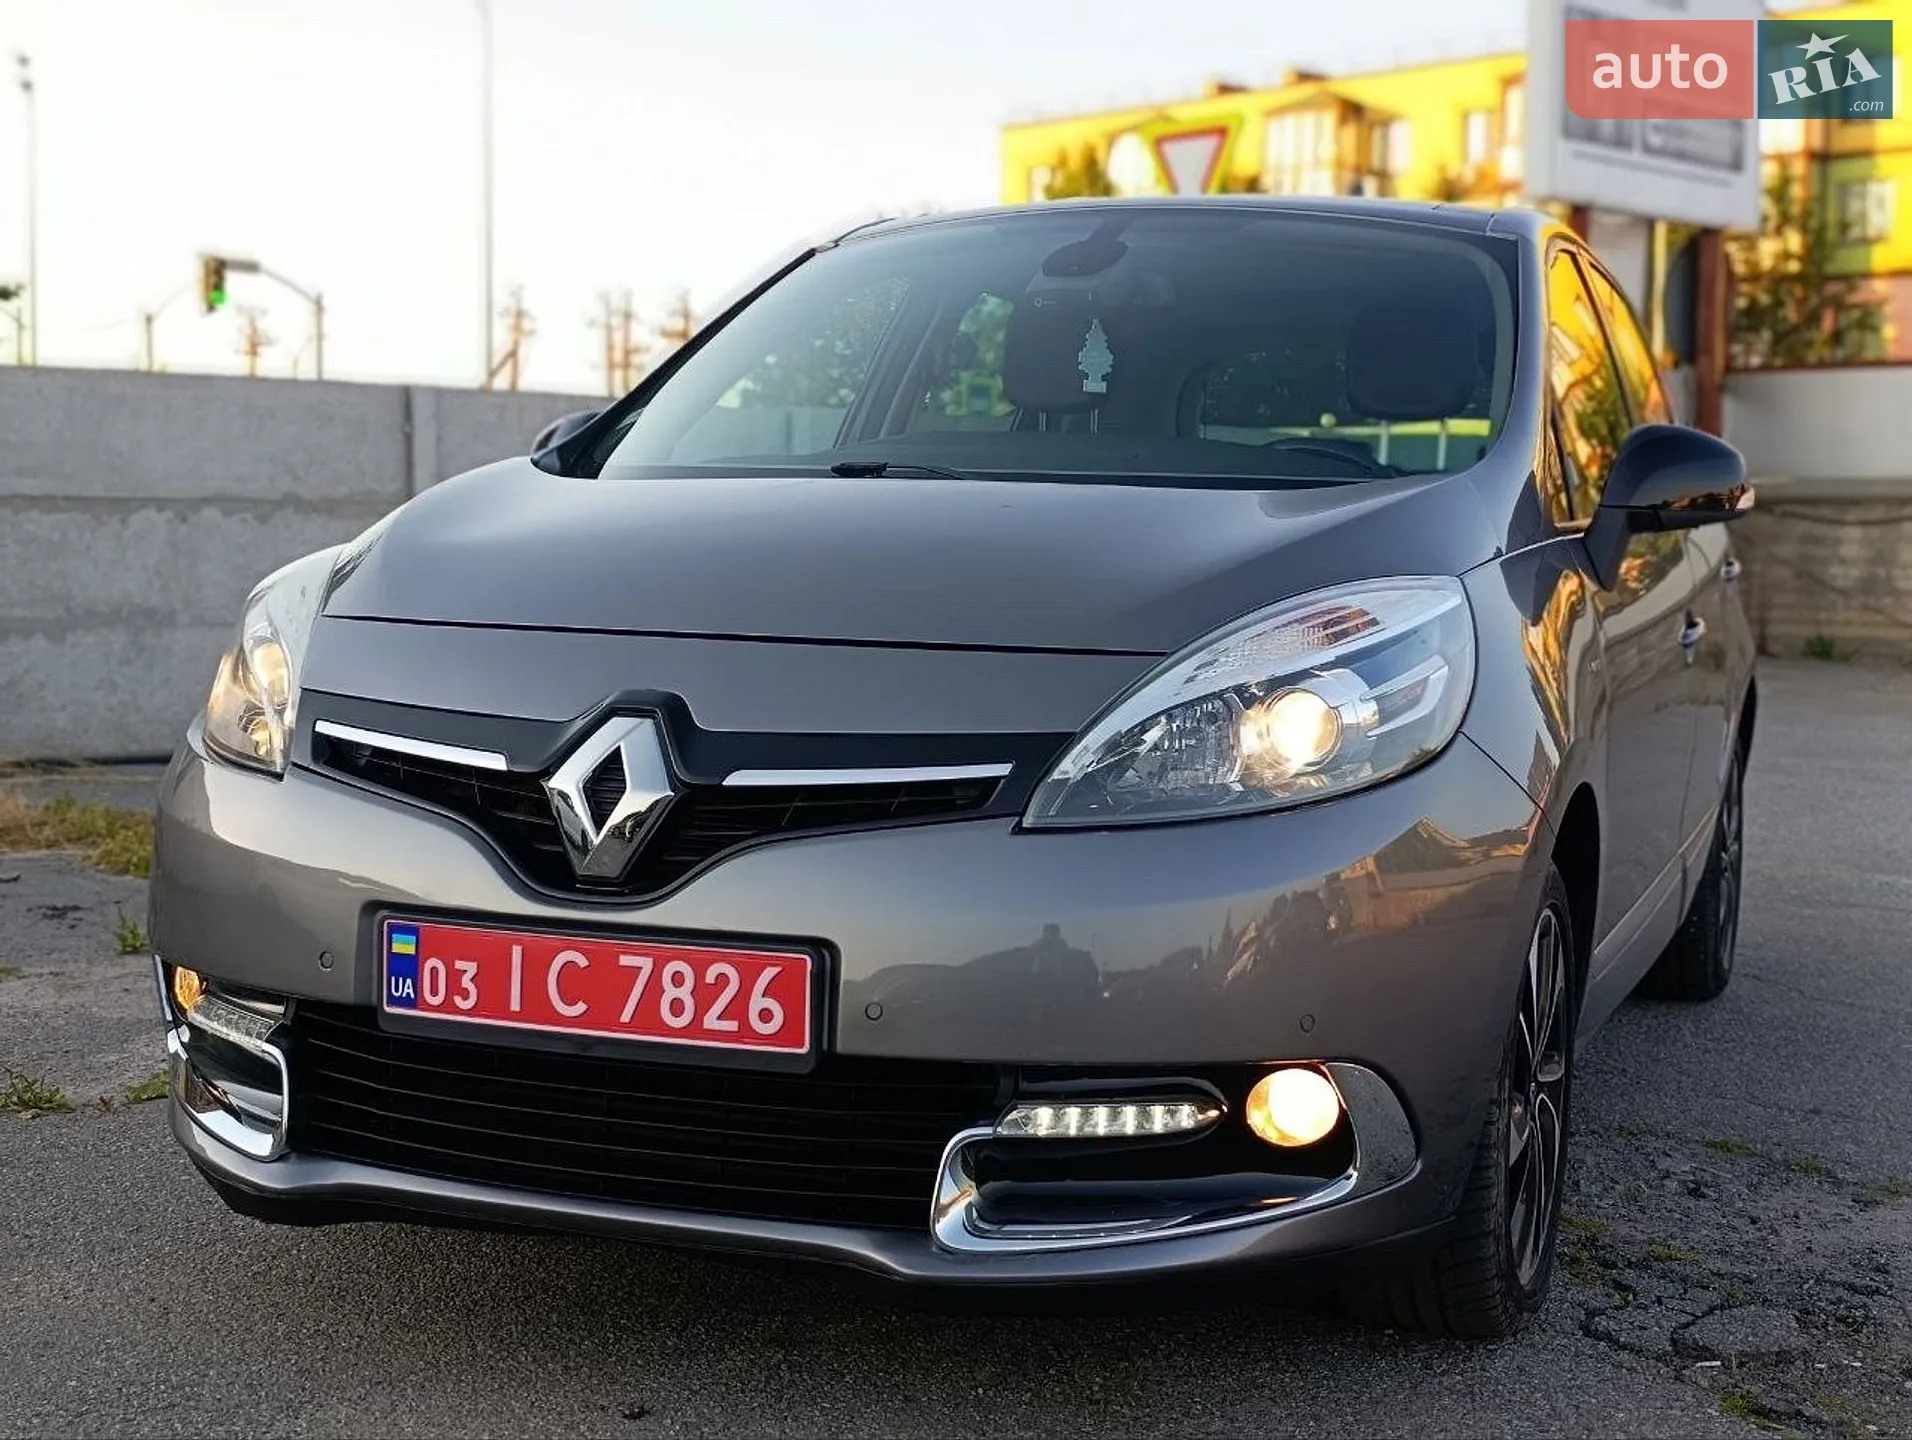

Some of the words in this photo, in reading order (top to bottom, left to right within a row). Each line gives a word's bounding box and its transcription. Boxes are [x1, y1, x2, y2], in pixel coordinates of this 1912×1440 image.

[391, 976, 415, 1000] UA
[422, 956, 479, 1010] 03
[618, 955, 785, 1036] 7826
